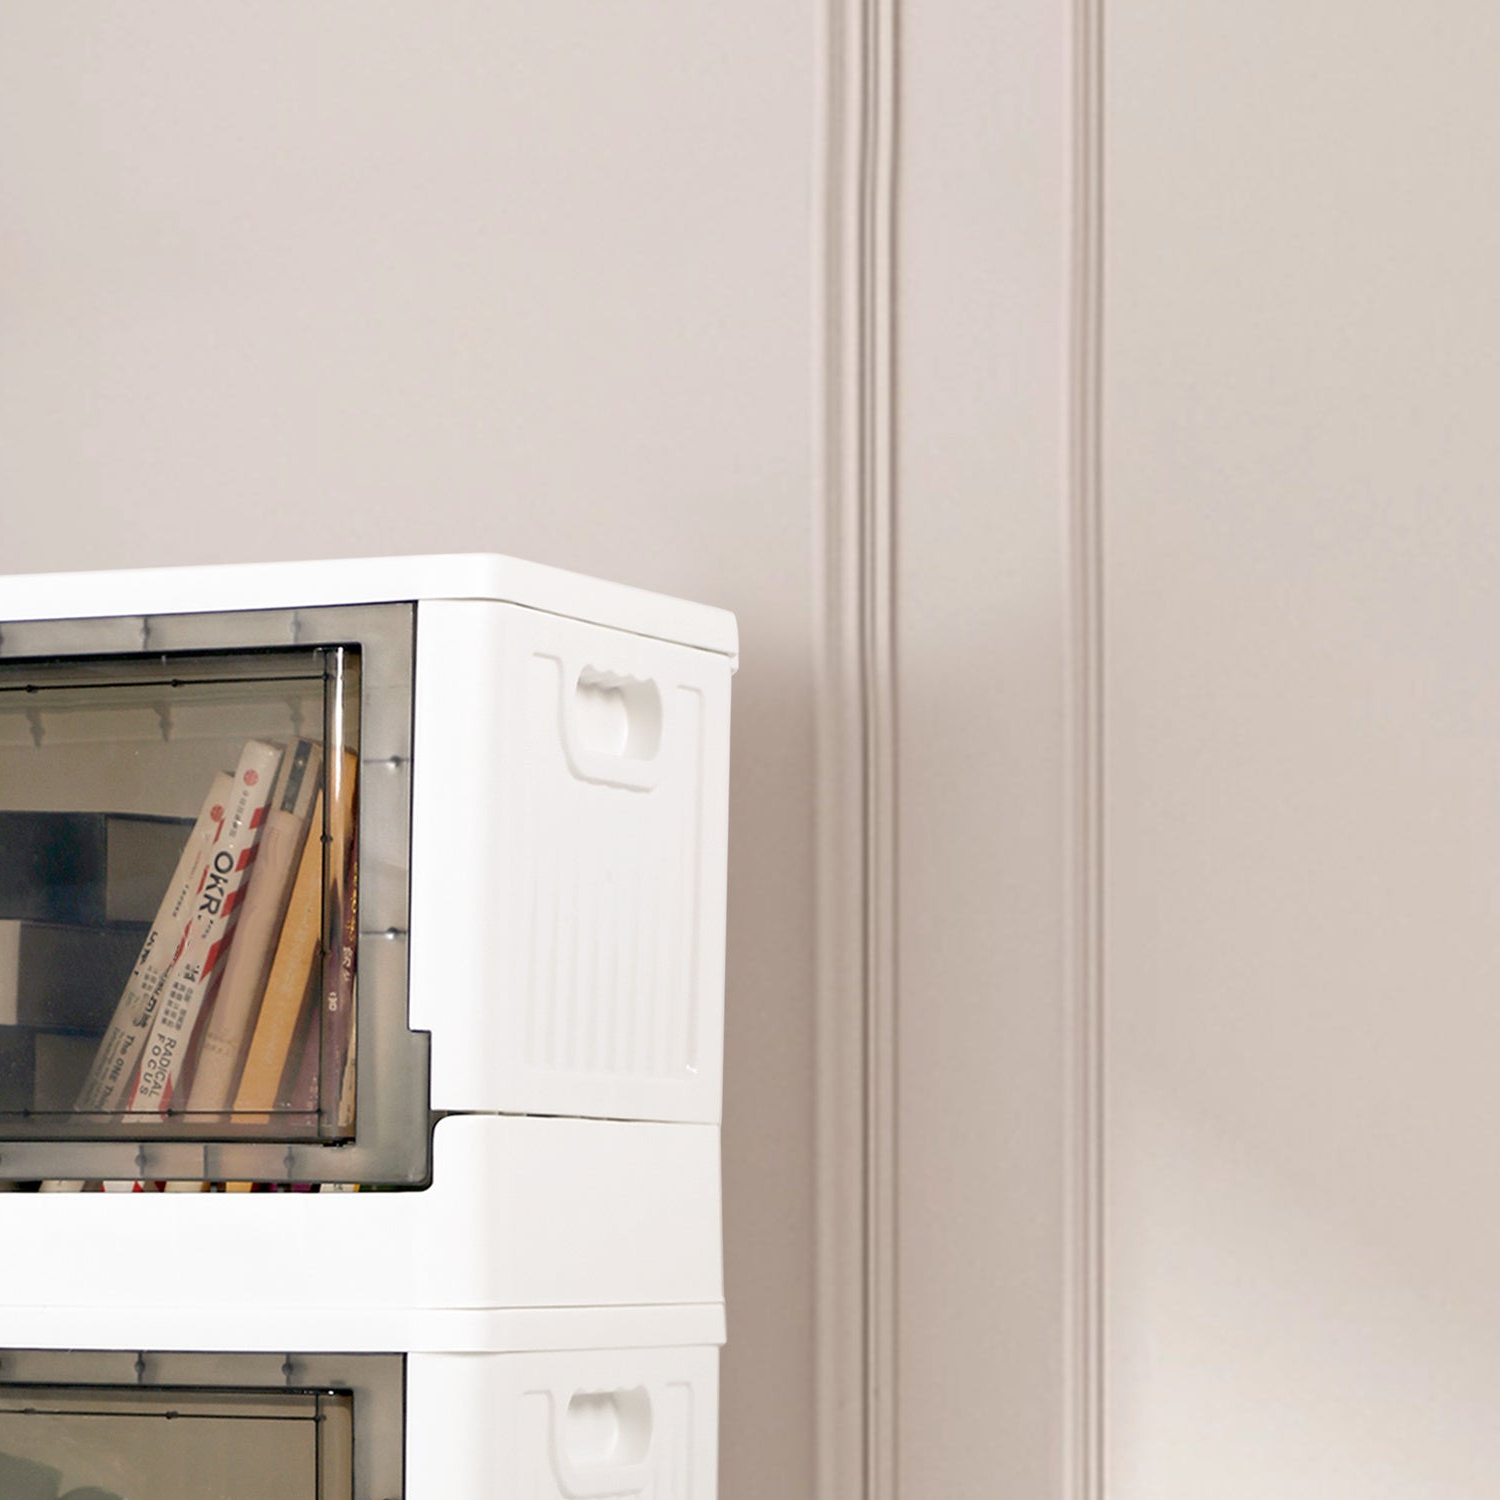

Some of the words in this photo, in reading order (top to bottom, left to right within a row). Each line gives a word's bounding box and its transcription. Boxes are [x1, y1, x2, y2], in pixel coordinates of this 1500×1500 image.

[120, 1033, 136, 1053] The
[140, 1032, 168, 1096] FOCUS
[148, 1036, 178, 1098] RADICAL
